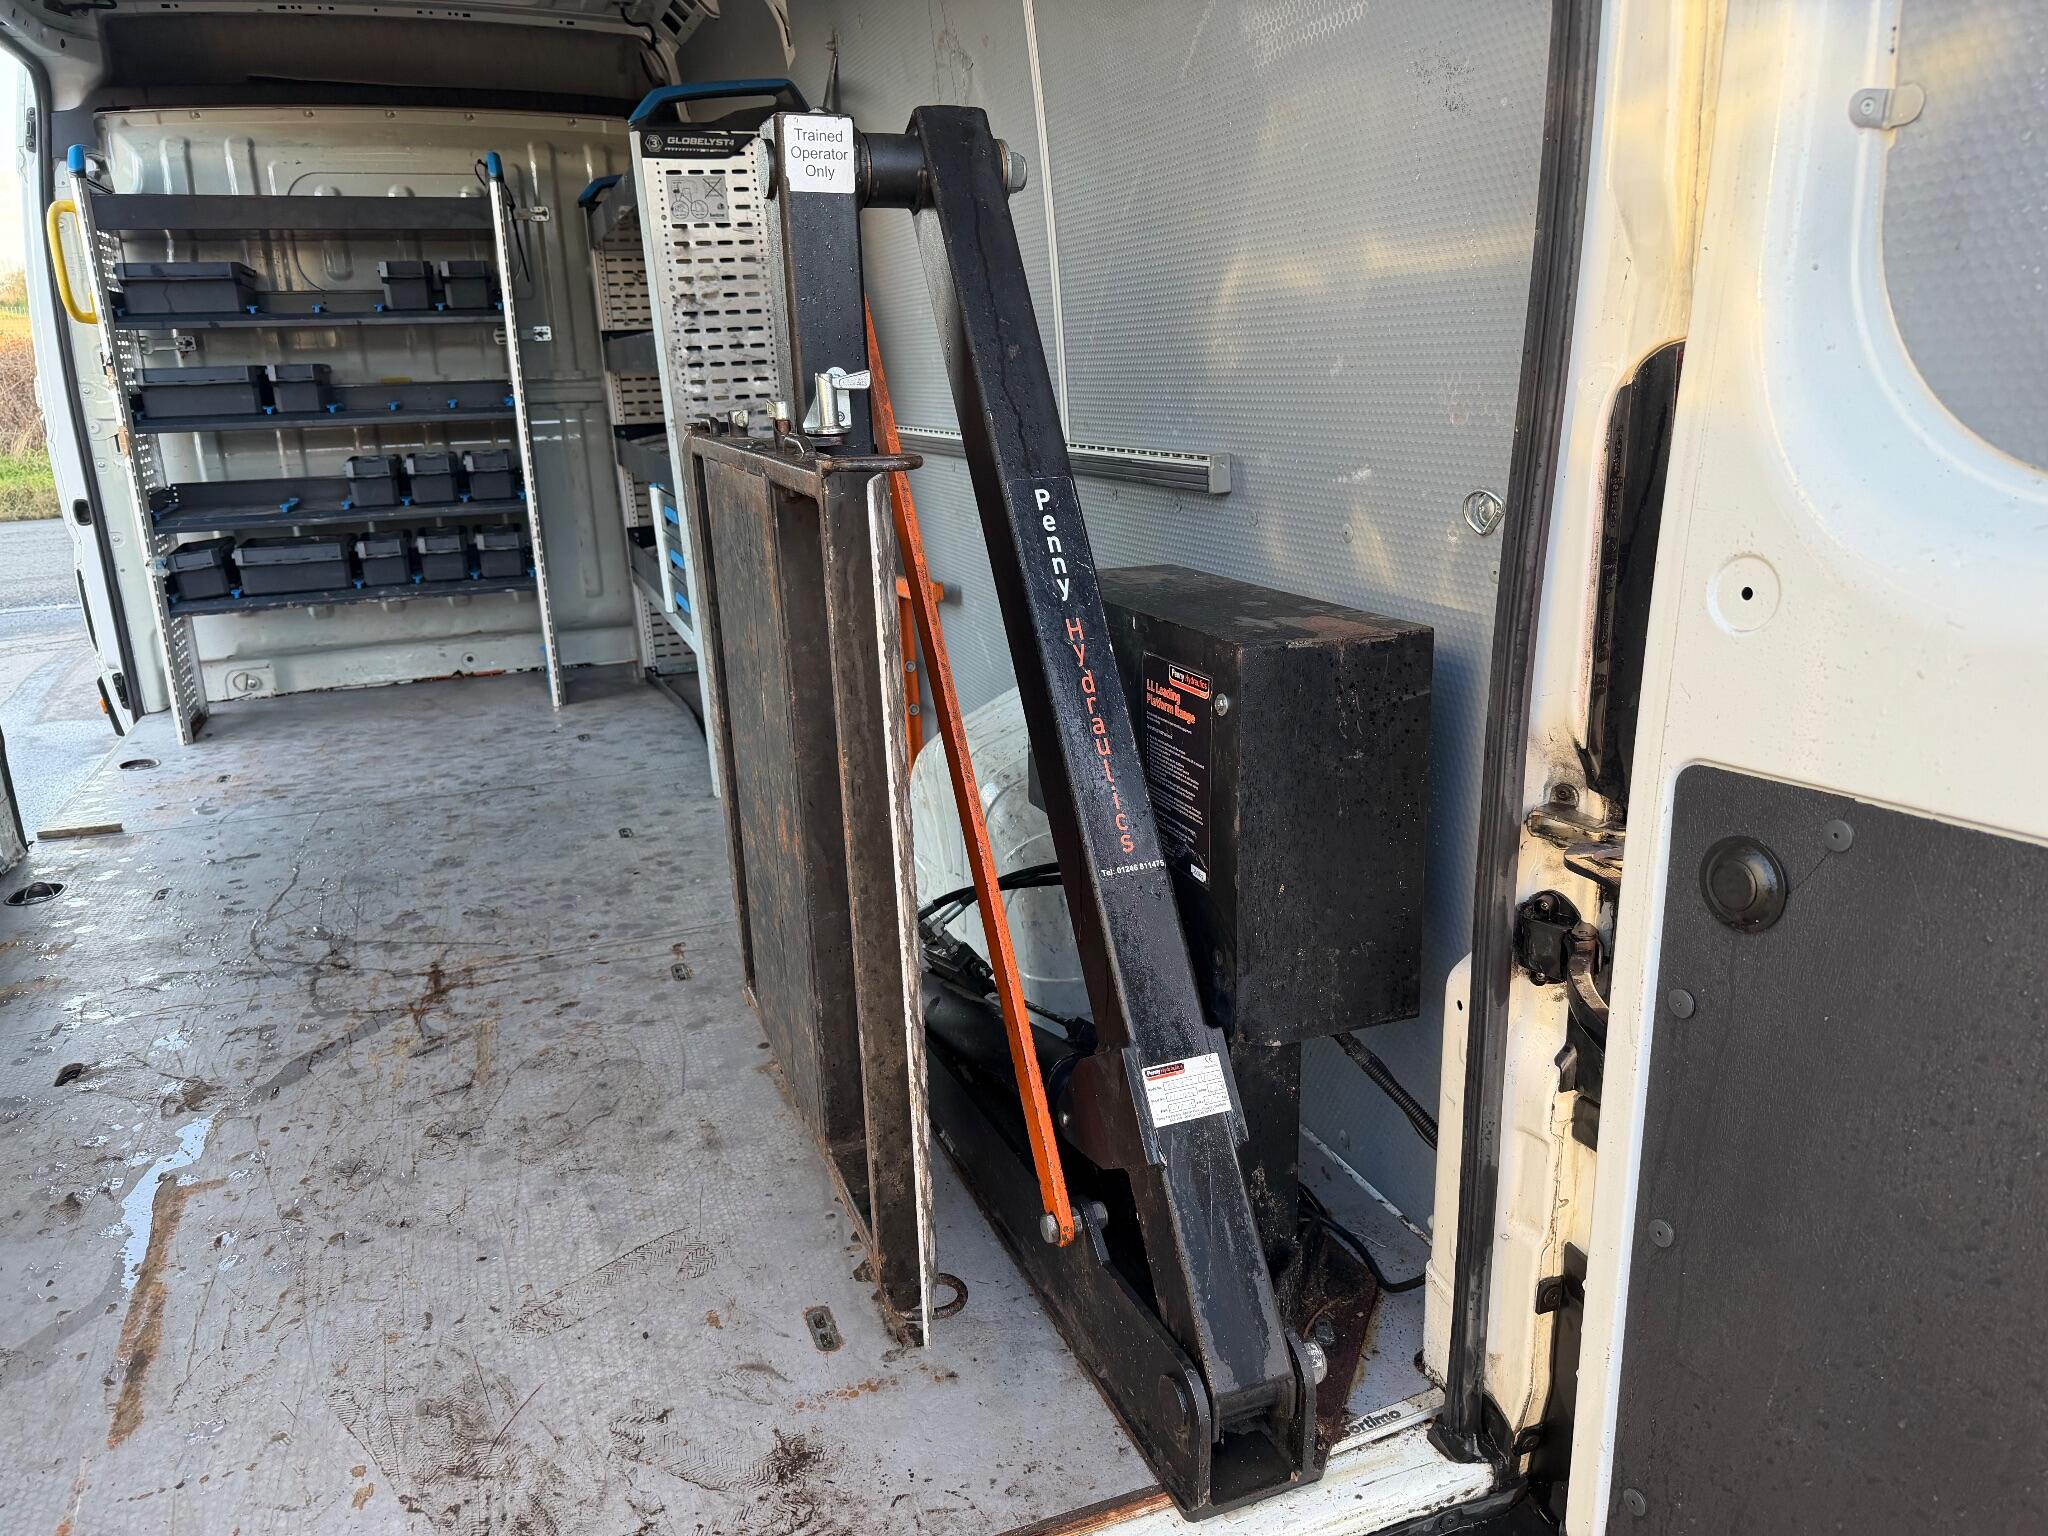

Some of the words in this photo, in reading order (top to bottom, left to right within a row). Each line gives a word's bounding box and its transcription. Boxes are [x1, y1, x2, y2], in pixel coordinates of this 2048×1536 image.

[667, 136, 735, 146] GLOBELYST4
[793, 127, 843, 143] Trained
[790, 145, 849, 162] Operator
[805, 164, 835, 181] Only
[1034, 488, 1070, 602] Penny
[1065, 617, 1135, 854] Hydraulics
[1155, 682, 1181, 706] Loading
[1146, 691, 1174, 715] Platform
[1174, 704, 1196, 725] Range
[1100, 869, 1116, 877] Tel:
[1116, 863, 1139, 874] 01246
[1139, 859, 1165, 870] 811475
